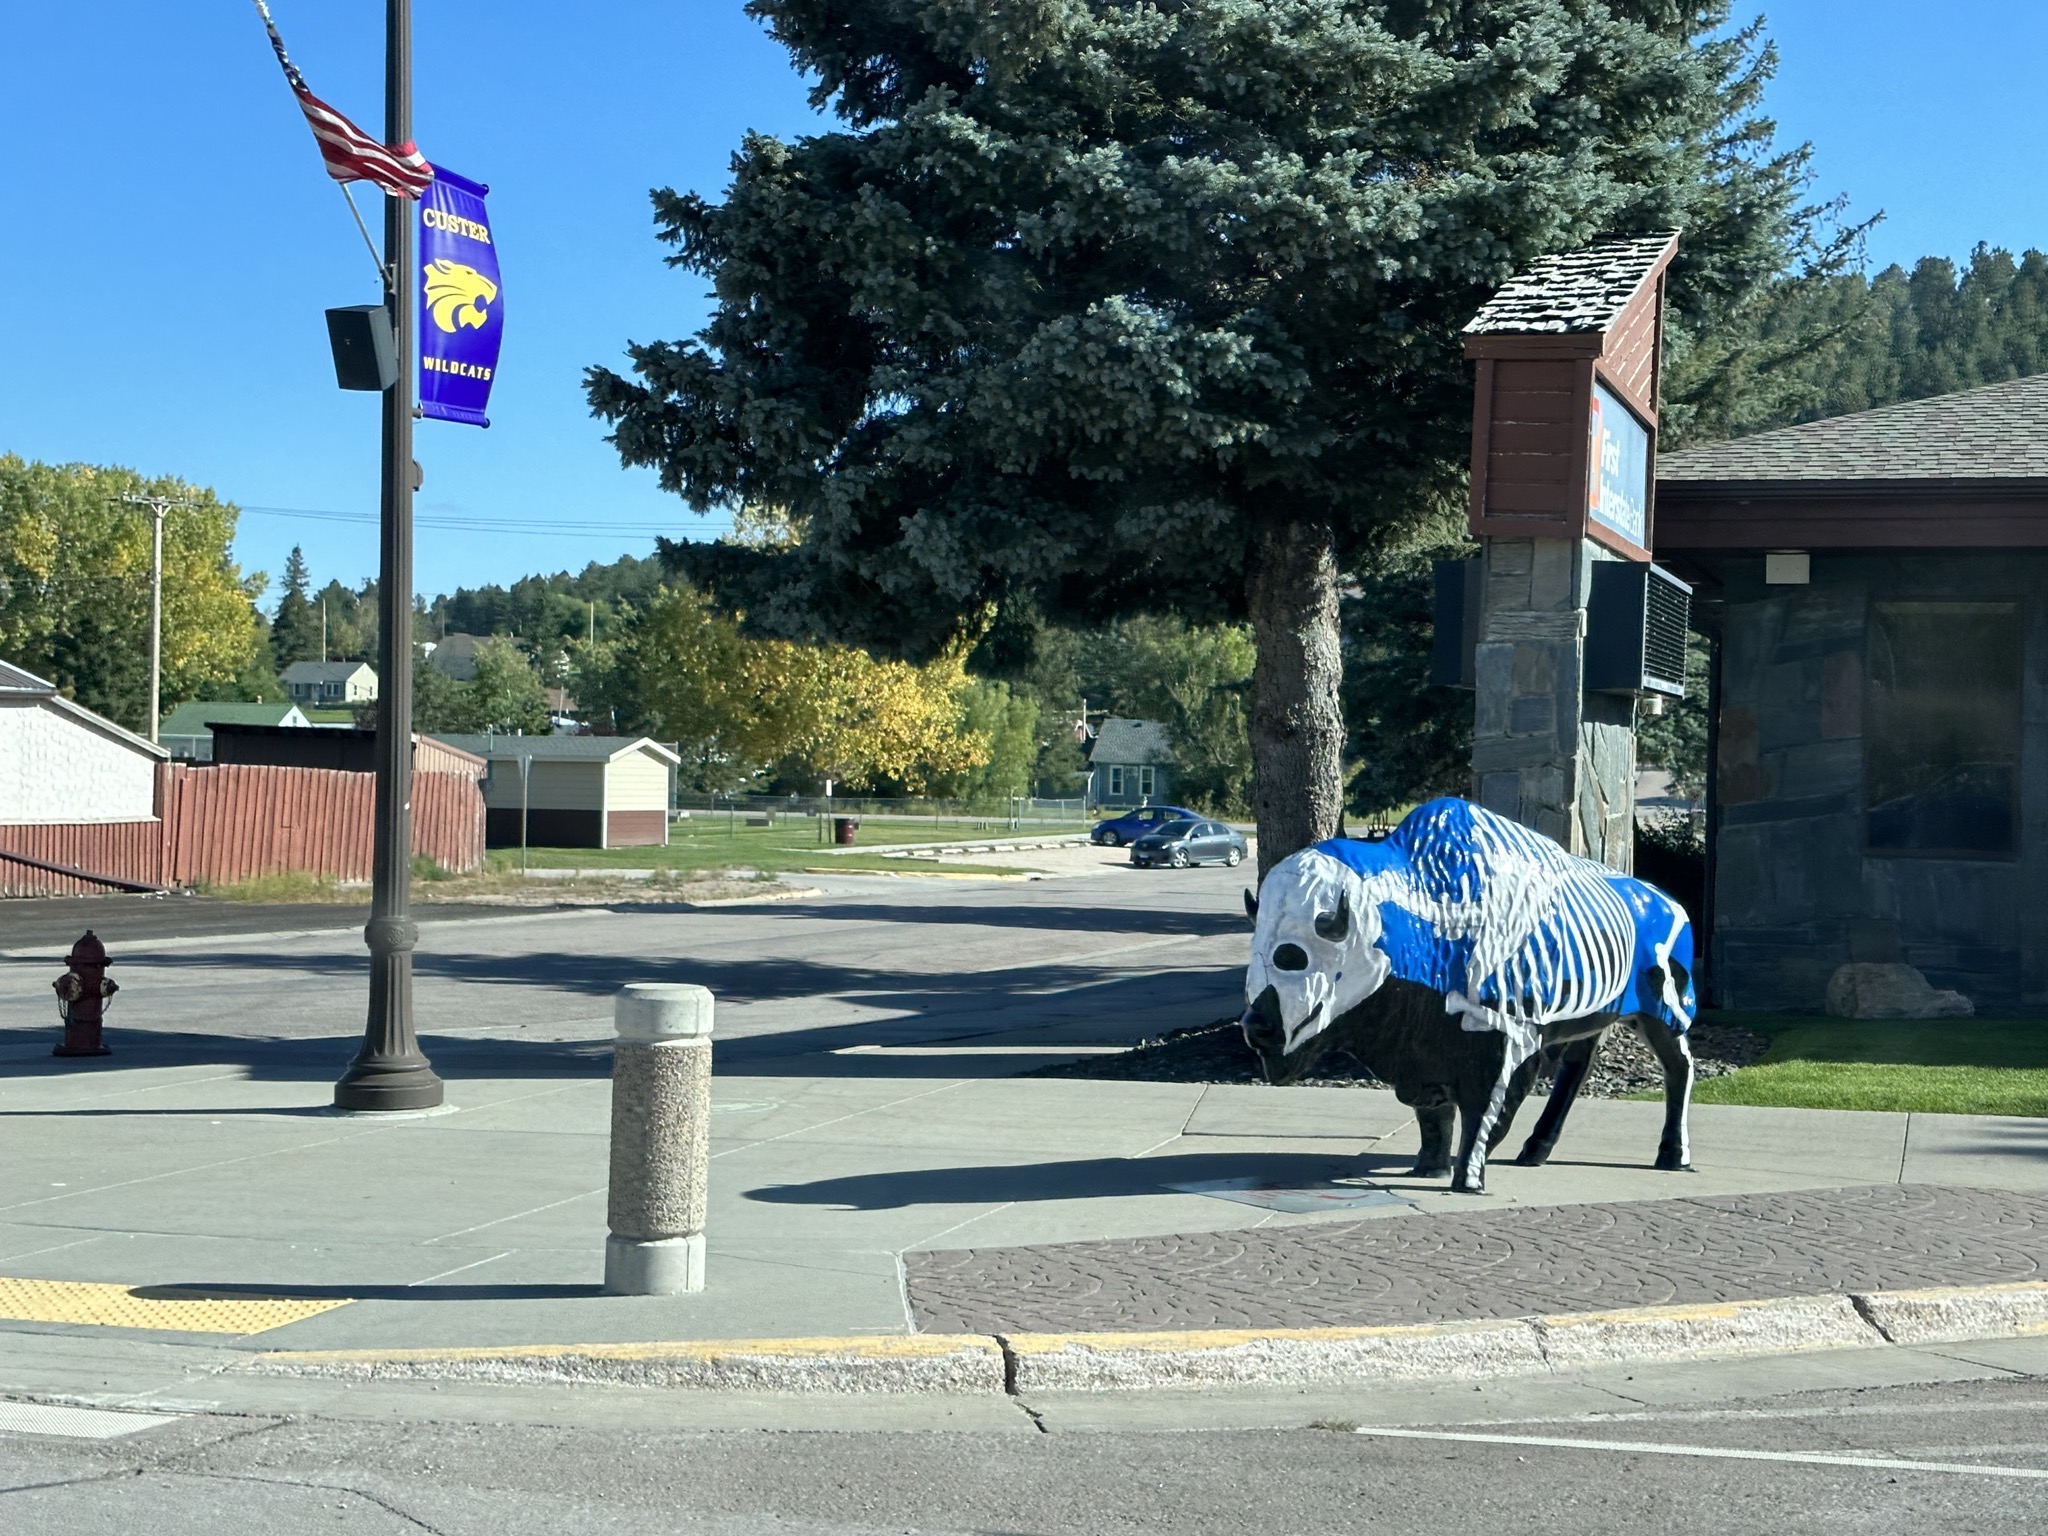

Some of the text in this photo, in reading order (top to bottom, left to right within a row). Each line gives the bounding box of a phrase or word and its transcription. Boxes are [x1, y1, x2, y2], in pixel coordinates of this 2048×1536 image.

[423, 208, 490, 244] CUSTER
[423, 356, 491, 381] WILDCATS
[1600, 429, 1620, 476] First
[1599, 475, 1630, 532] Interstate
